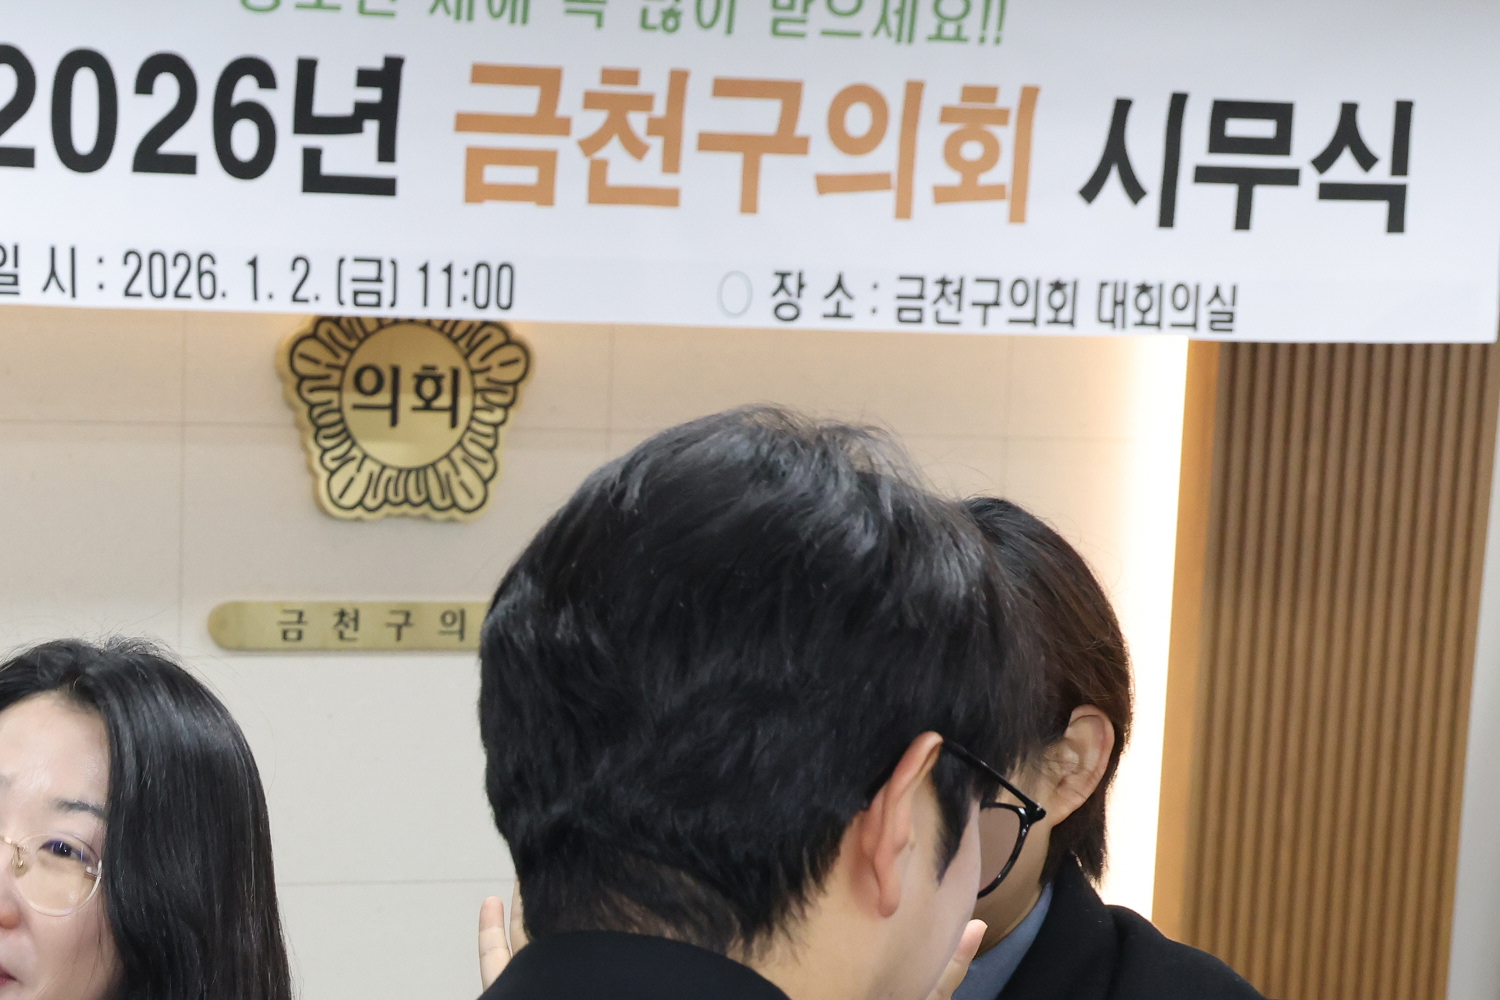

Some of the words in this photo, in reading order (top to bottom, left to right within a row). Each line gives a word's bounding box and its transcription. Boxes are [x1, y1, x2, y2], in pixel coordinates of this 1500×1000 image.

[454, 64, 1041, 224] 금천구의회
[1077, 91, 1415, 234] 시무식
[121, 248, 227, 302] 2026.
[417, 260, 516, 312] 11:00
[895, 274, 1079, 329] 금천구의회
[1096, 280, 1238, 334] 대회의실
[352, 363, 460, 428] 의회
